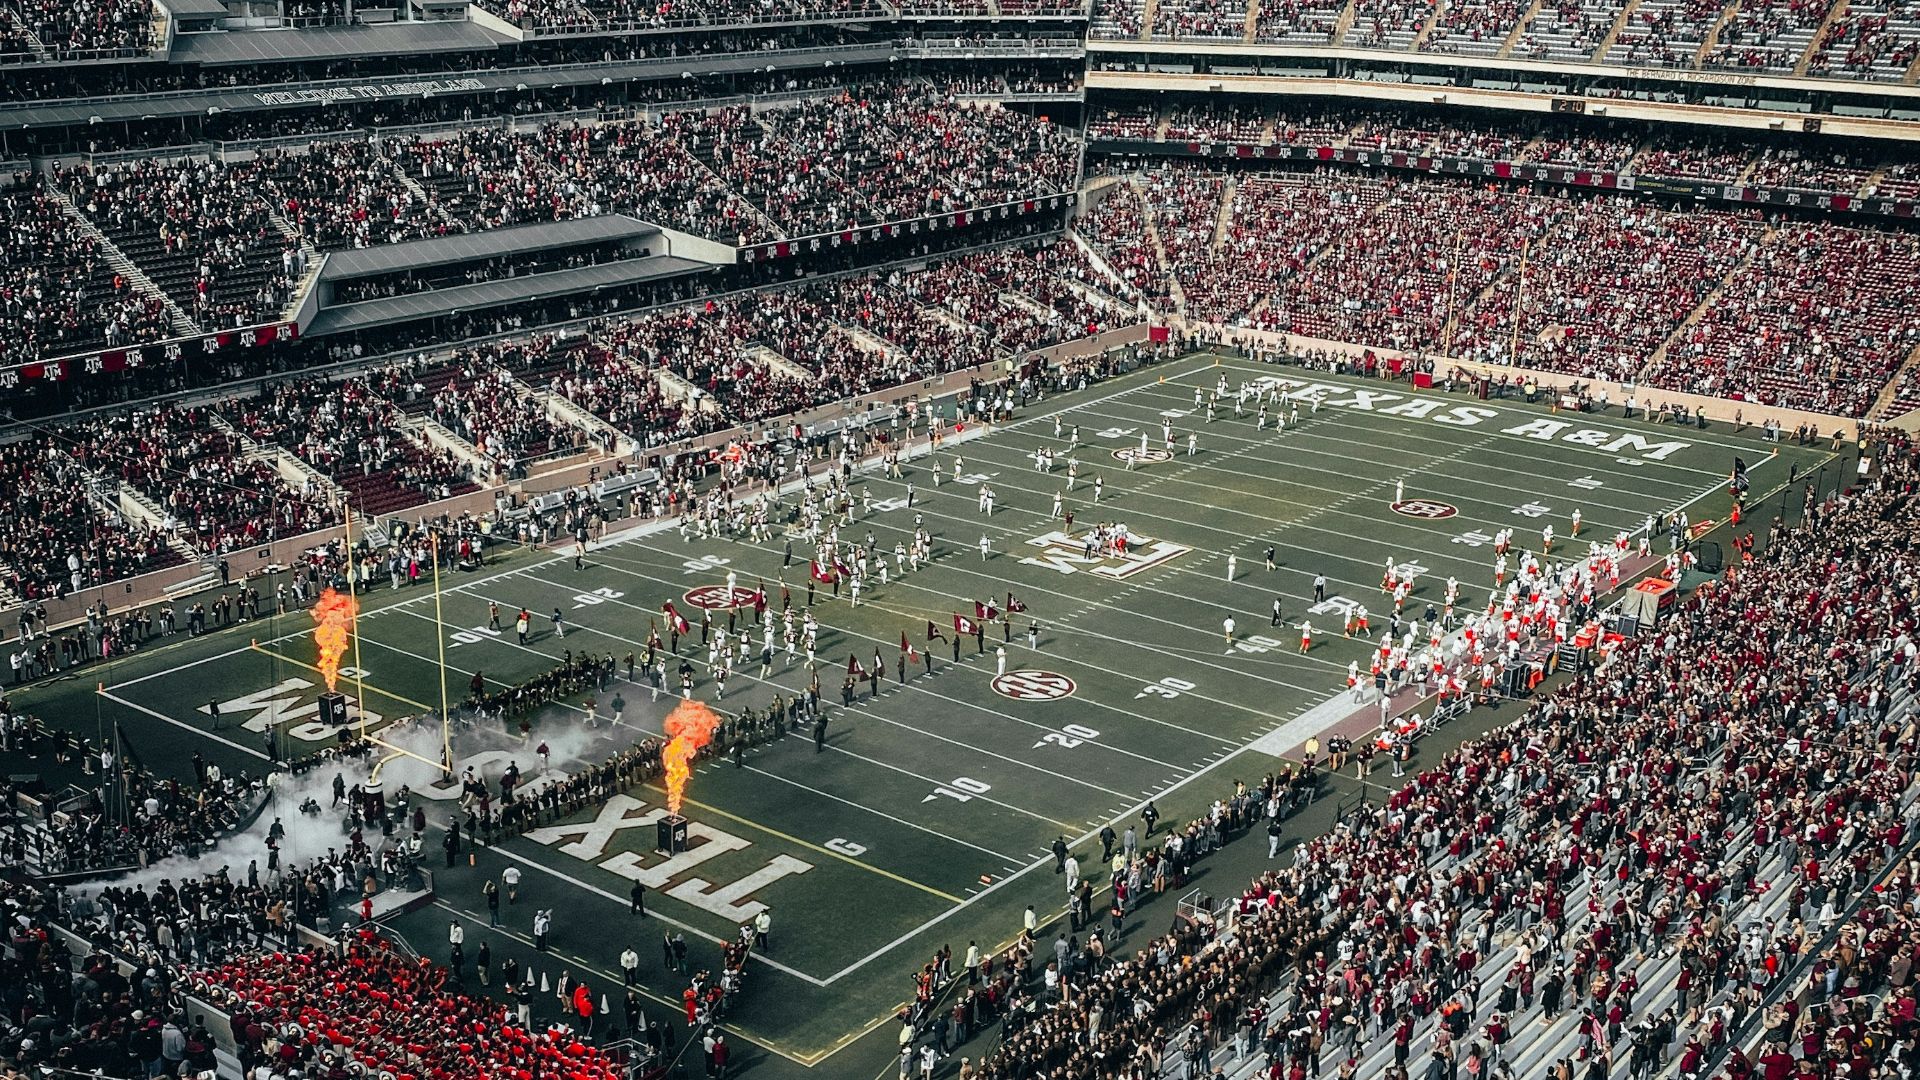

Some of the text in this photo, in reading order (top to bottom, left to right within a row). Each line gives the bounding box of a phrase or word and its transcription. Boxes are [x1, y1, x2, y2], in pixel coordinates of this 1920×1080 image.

[254, 78, 485, 106] WELCOME TO AGGIELAND
[1501, 418, 1692, 460] A&M
[573, 587, 624, 605] 20
[1235, 635, 1282, 653] 40
[1144, 677, 1196, 699] 30
[1044, 724, 1100, 749] 20
[934, 777, 991, 802] 10
[824, 838, 867, 856] G
[1344, 945, 1352, 954] 12
